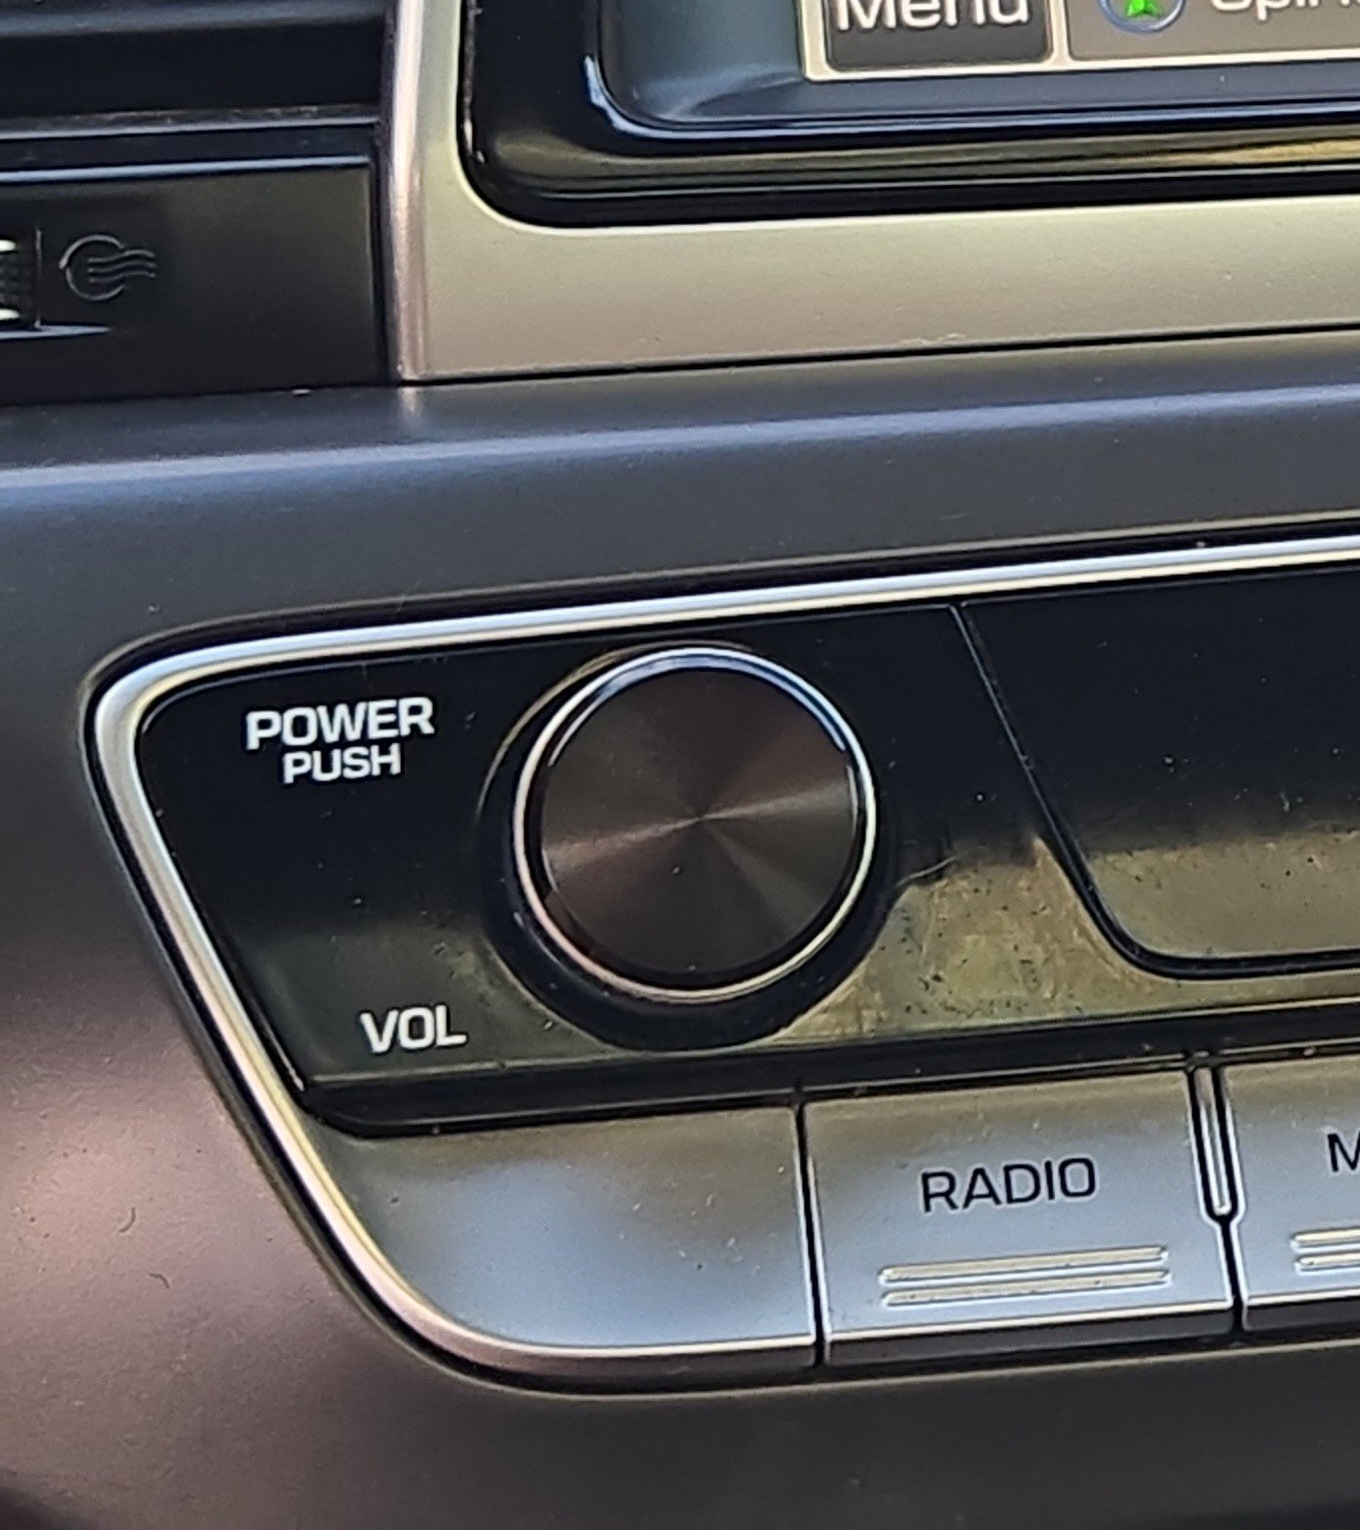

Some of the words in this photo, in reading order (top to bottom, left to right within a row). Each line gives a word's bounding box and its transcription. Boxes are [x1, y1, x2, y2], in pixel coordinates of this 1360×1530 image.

[246, 696, 435, 752] POWER
[283, 742, 402, 786] PUSH
[360, 1003, 468, 1054] VOL
[919, 1157, 1099, 1214] RADIO
